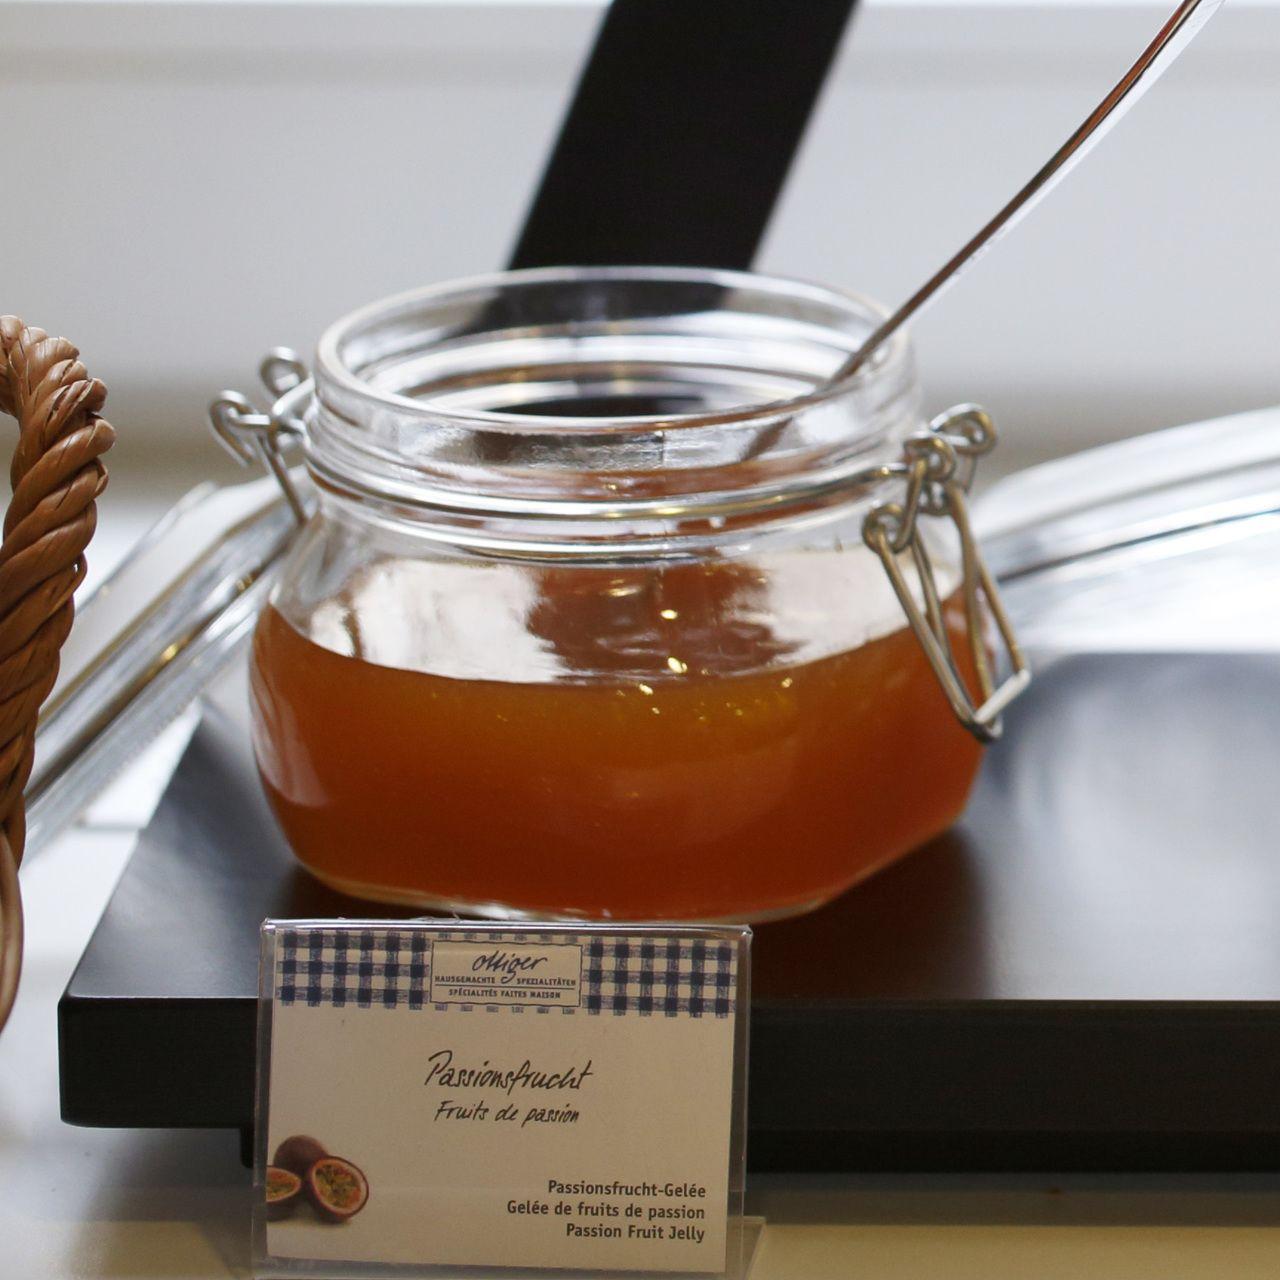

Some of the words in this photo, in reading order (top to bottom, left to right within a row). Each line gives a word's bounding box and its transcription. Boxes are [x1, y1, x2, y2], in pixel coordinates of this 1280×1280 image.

[434, 975, 496, 984] HAUSGEMACHTE
[516, 978, 576, 987] SPEZIALITÄTEN
[424, 1050, 593, 1095] Passionsfrucht
[435, 1100, 489, 1120] Fruits
[495, 1104, 518, 1121] de
[521, 1104, 579, 1127] passion
[549, 1180, 706, 1197] Passionsfrucht-Gelée
[508, 1200, 549, 1214] Gelée
[555, 1201, 571, 1215] de
[578, 1202, 619, 1216] fruits
[625, 1203, 642, 1217] de
[649, 1205, 704, 1221] passion
[567, 1223, 621, 1237] Passion
[628, 1225, 664, 1239] Fruit
[669, 1226, 704, 1243] Jelly
